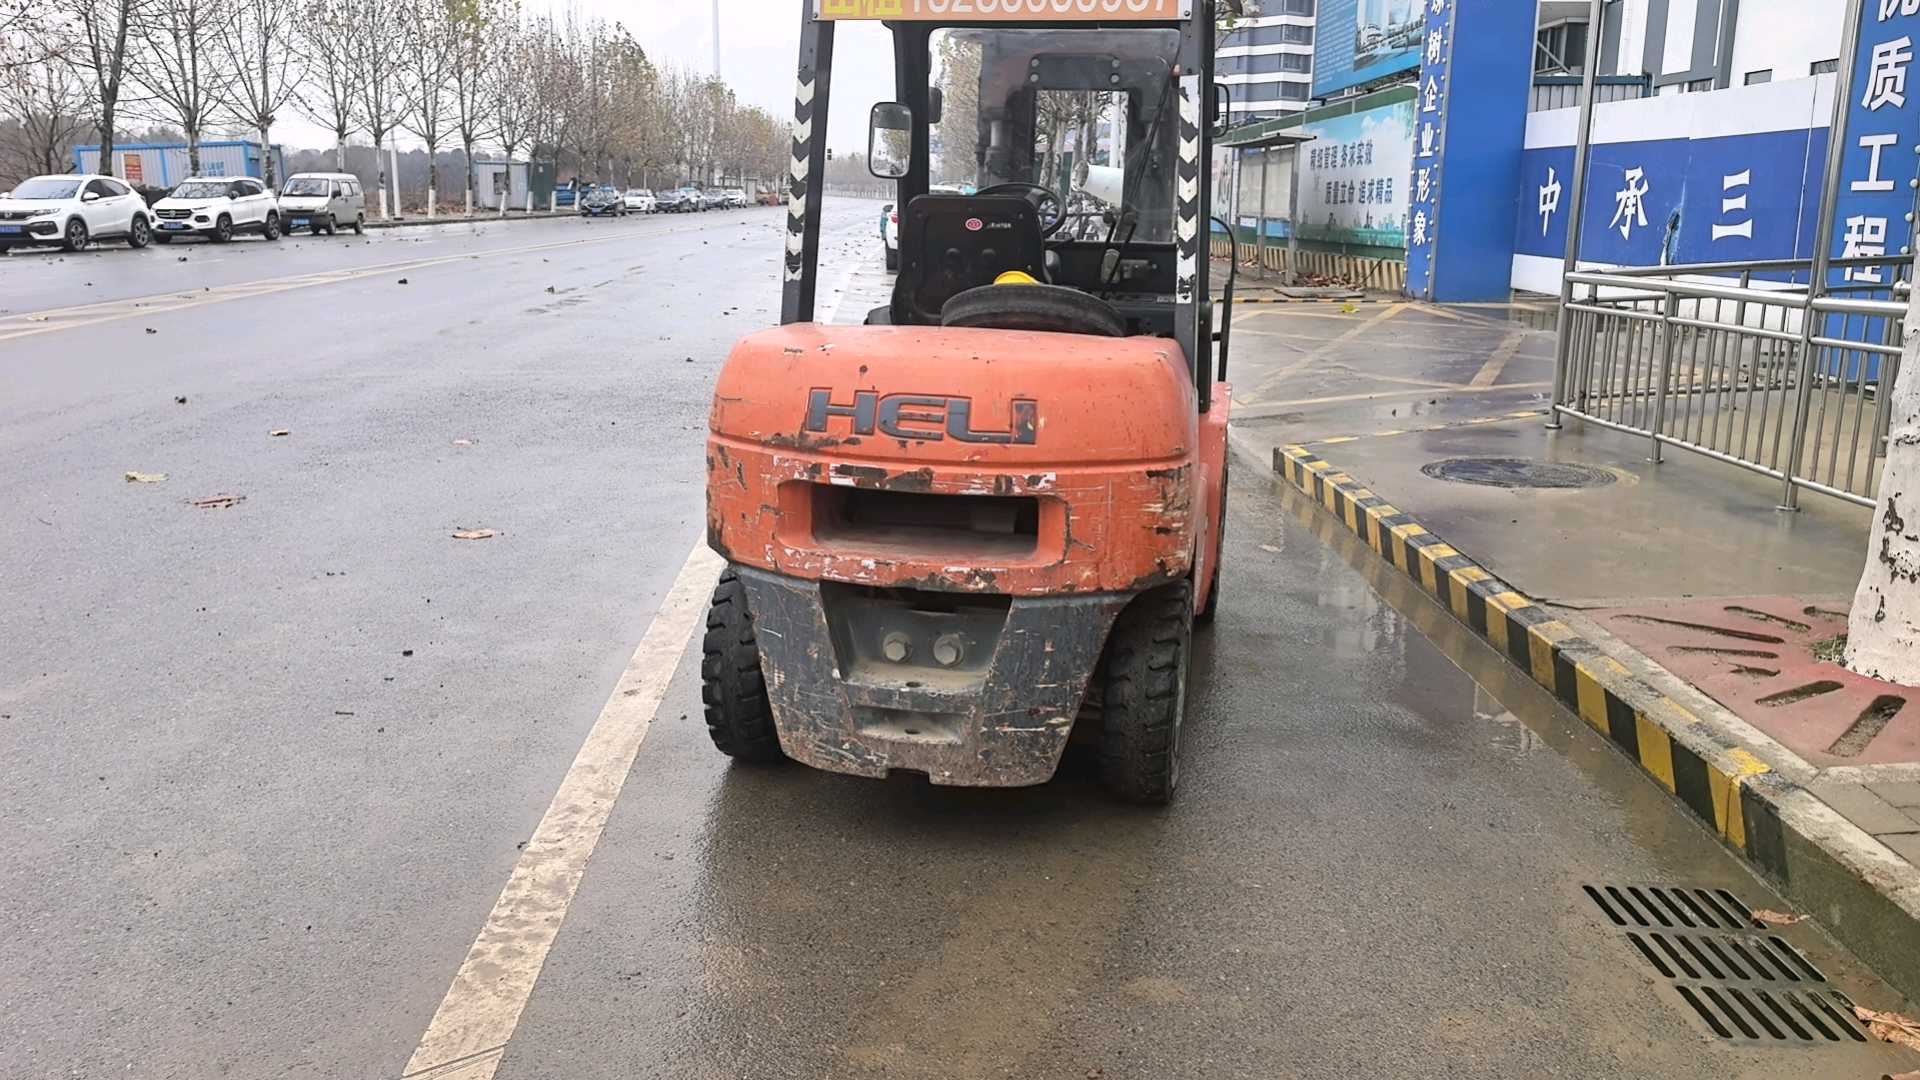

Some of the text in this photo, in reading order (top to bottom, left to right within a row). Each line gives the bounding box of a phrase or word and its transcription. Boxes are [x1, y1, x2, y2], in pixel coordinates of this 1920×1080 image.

[1842, 0, 1920, 283] 质工程
[805, 386, 1038, 445] HELI
